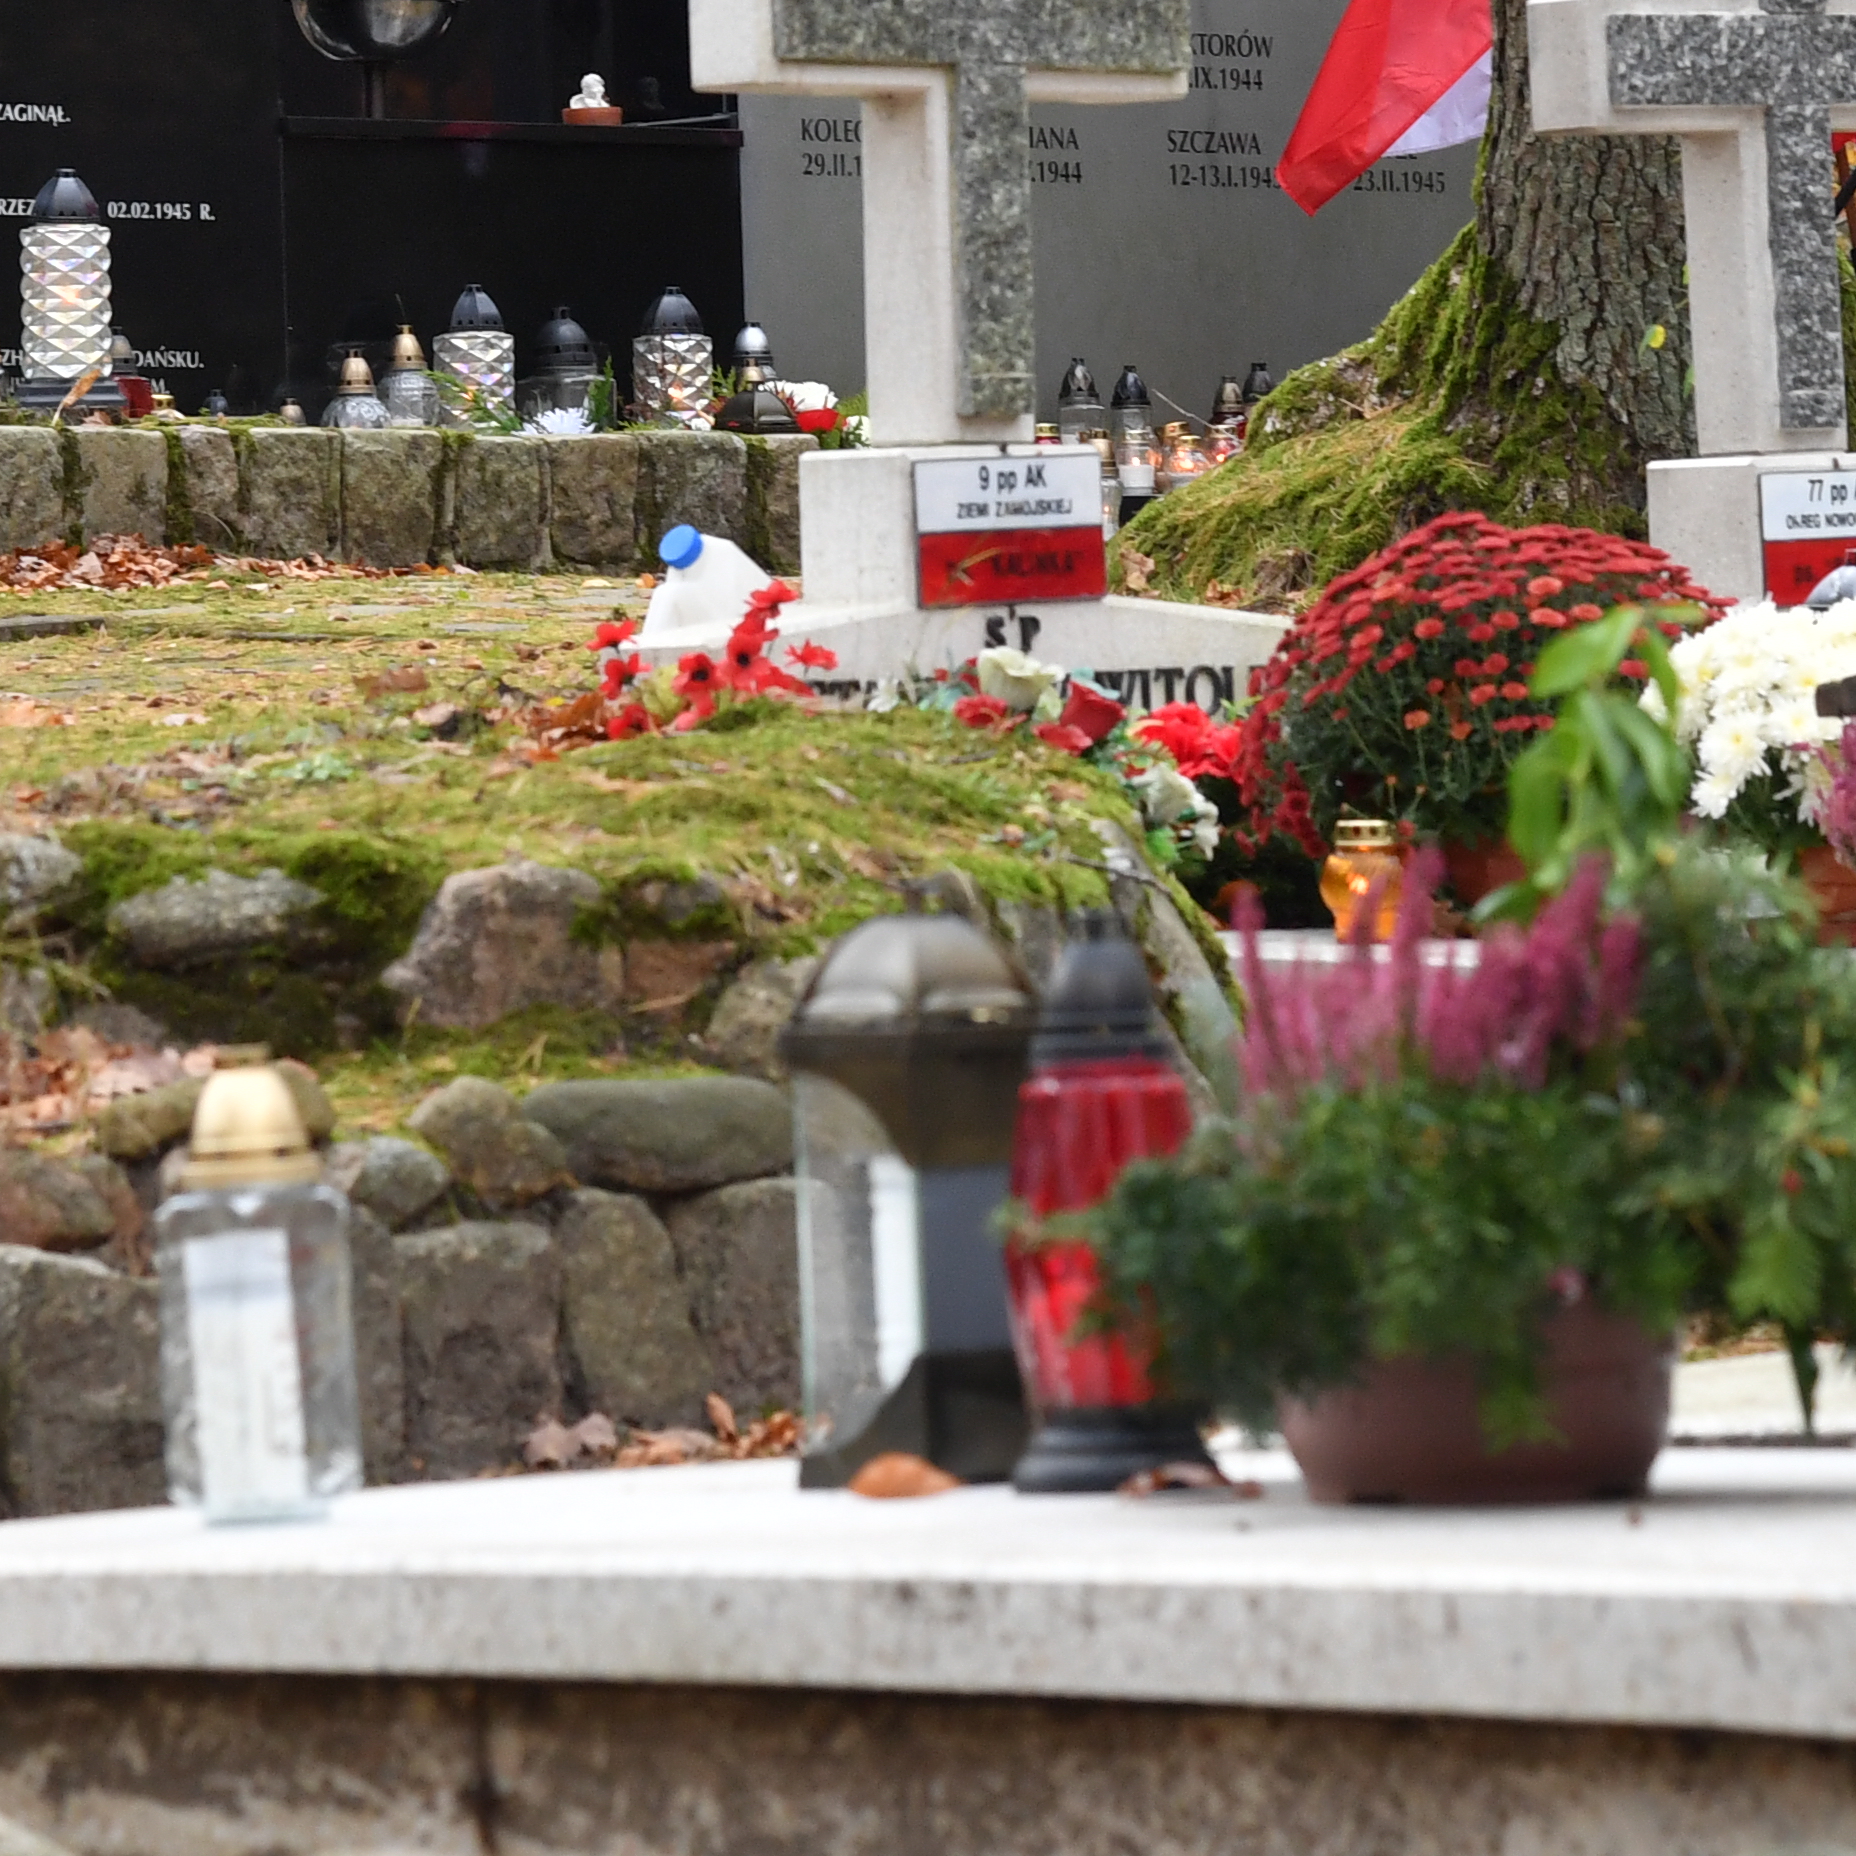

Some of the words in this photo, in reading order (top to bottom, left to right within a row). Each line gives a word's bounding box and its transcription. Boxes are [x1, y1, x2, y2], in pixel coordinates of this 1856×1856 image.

[1168, 130, 1261, 155] SZCZAWA
[978, 465, 991, 490] 9
[997, 470, 1018, 494] pp
[1025, 464, 1047, 488] AK
[1808, 479, 1824, 502] 77
[1830, 484, 1848, 505] pp
